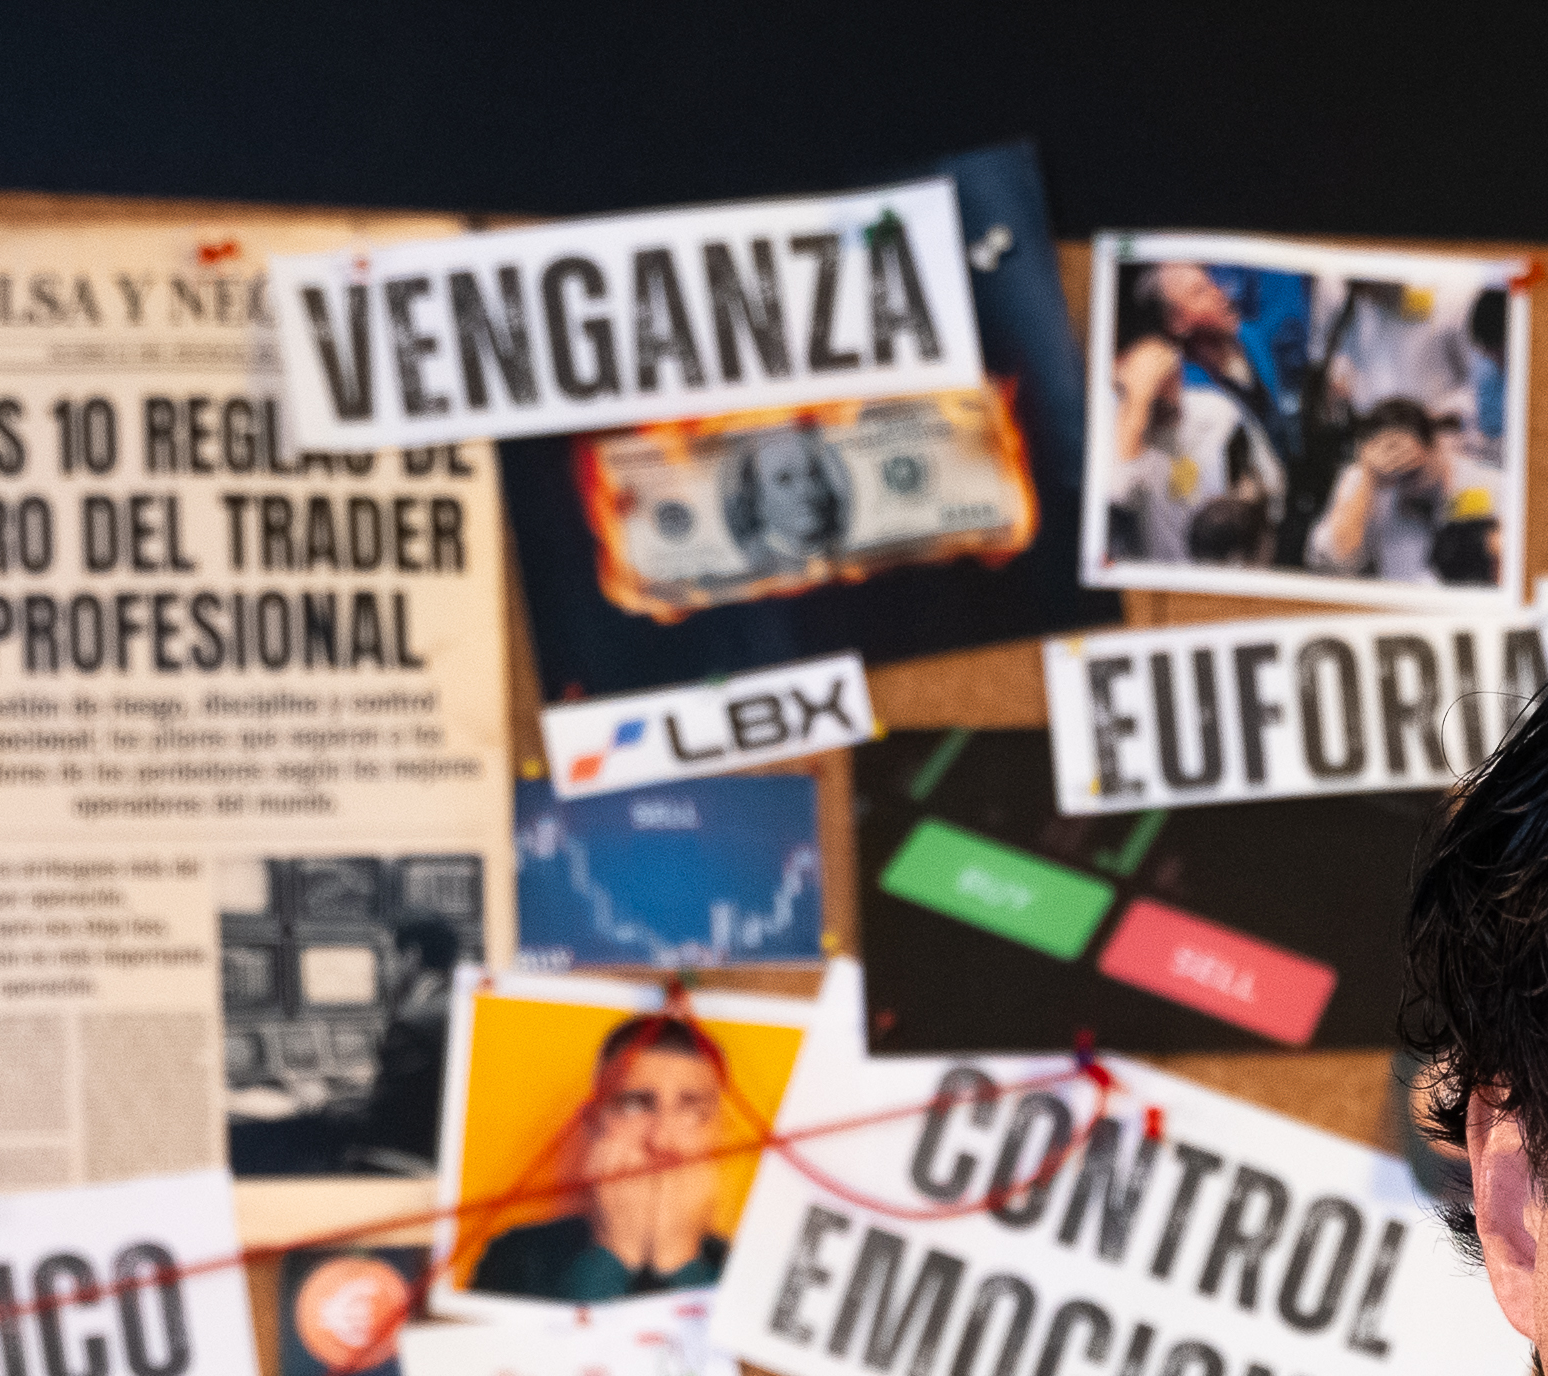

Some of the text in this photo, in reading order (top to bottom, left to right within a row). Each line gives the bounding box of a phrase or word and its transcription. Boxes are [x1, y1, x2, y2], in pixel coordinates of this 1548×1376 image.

[114, 273, 154, 326] Y
[301, 218, 946, 428] VENGANZA
[52, 399, 118, 477] 10
[81, 494, 199, 576] DEL
[225, 493, 468, 576] TRADER
[666, 676, 854, 766] LBX
[955, 866, 1035, 914] BUY
[1168, 943, 1258, 1002] SELL
[909, 1066, 1410, 1359] CONTROL
